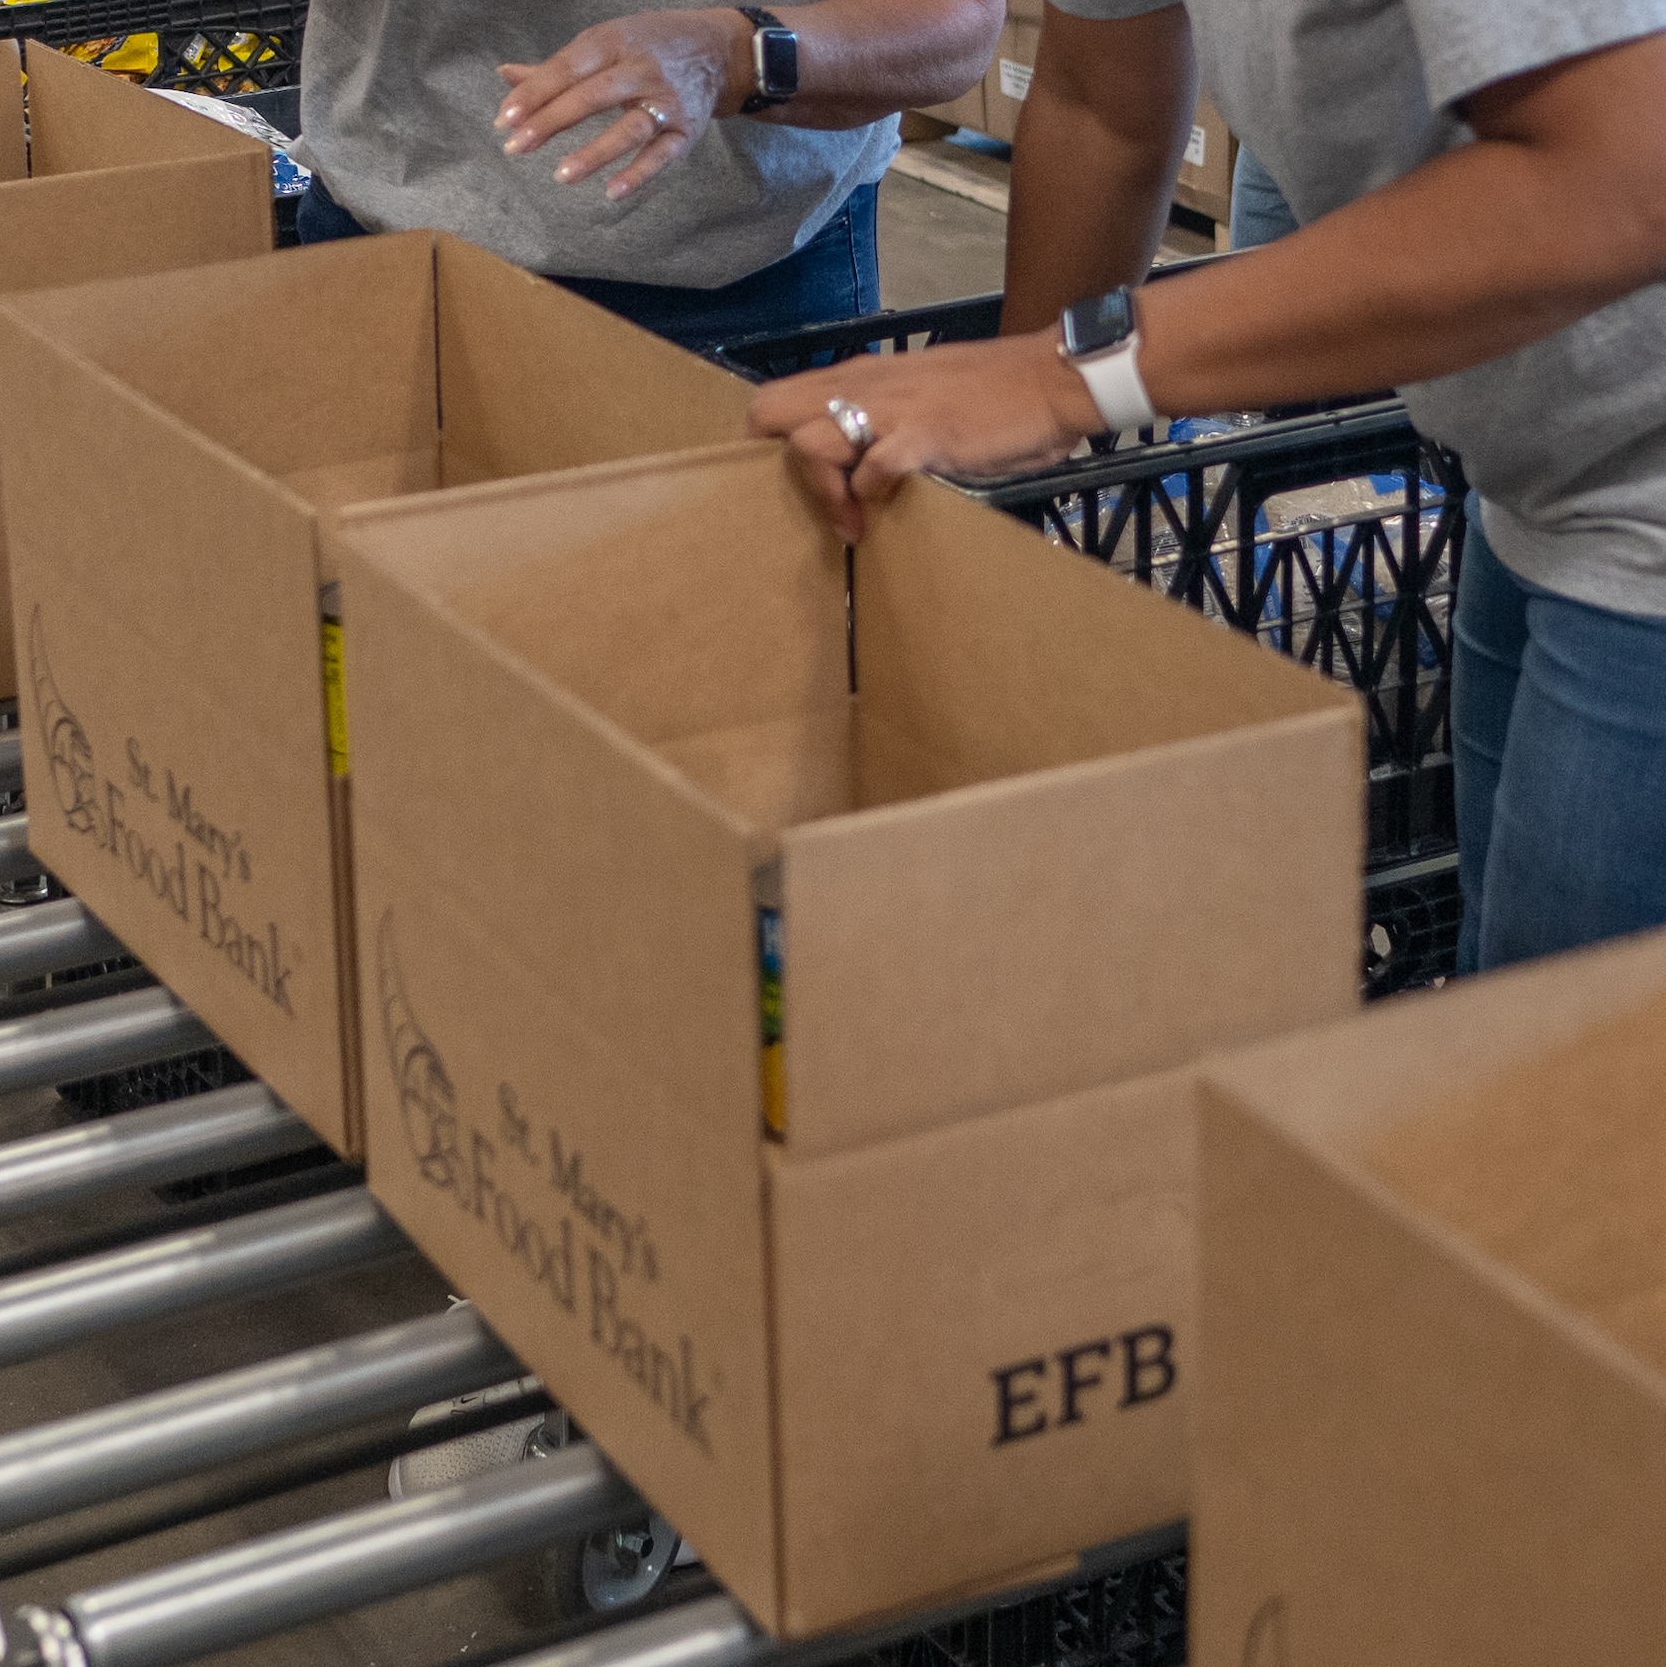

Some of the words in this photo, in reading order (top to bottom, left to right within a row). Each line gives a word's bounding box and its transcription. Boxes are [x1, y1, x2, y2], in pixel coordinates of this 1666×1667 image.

[105, 776, 190, 923] Food
[197, 860, 297, 1022] Bank
[127, 735, 159, 804] St.
[165, 767, 252, 883] Mary's
[497, 1081, 539, 1168] St.
[550, 1126, 661, 1284] Mary's
[470, 1131, 577, 1318] Food
[587, 1241, 719, 1462] Bank
[988, 1320, 1179, 1449] EFB
